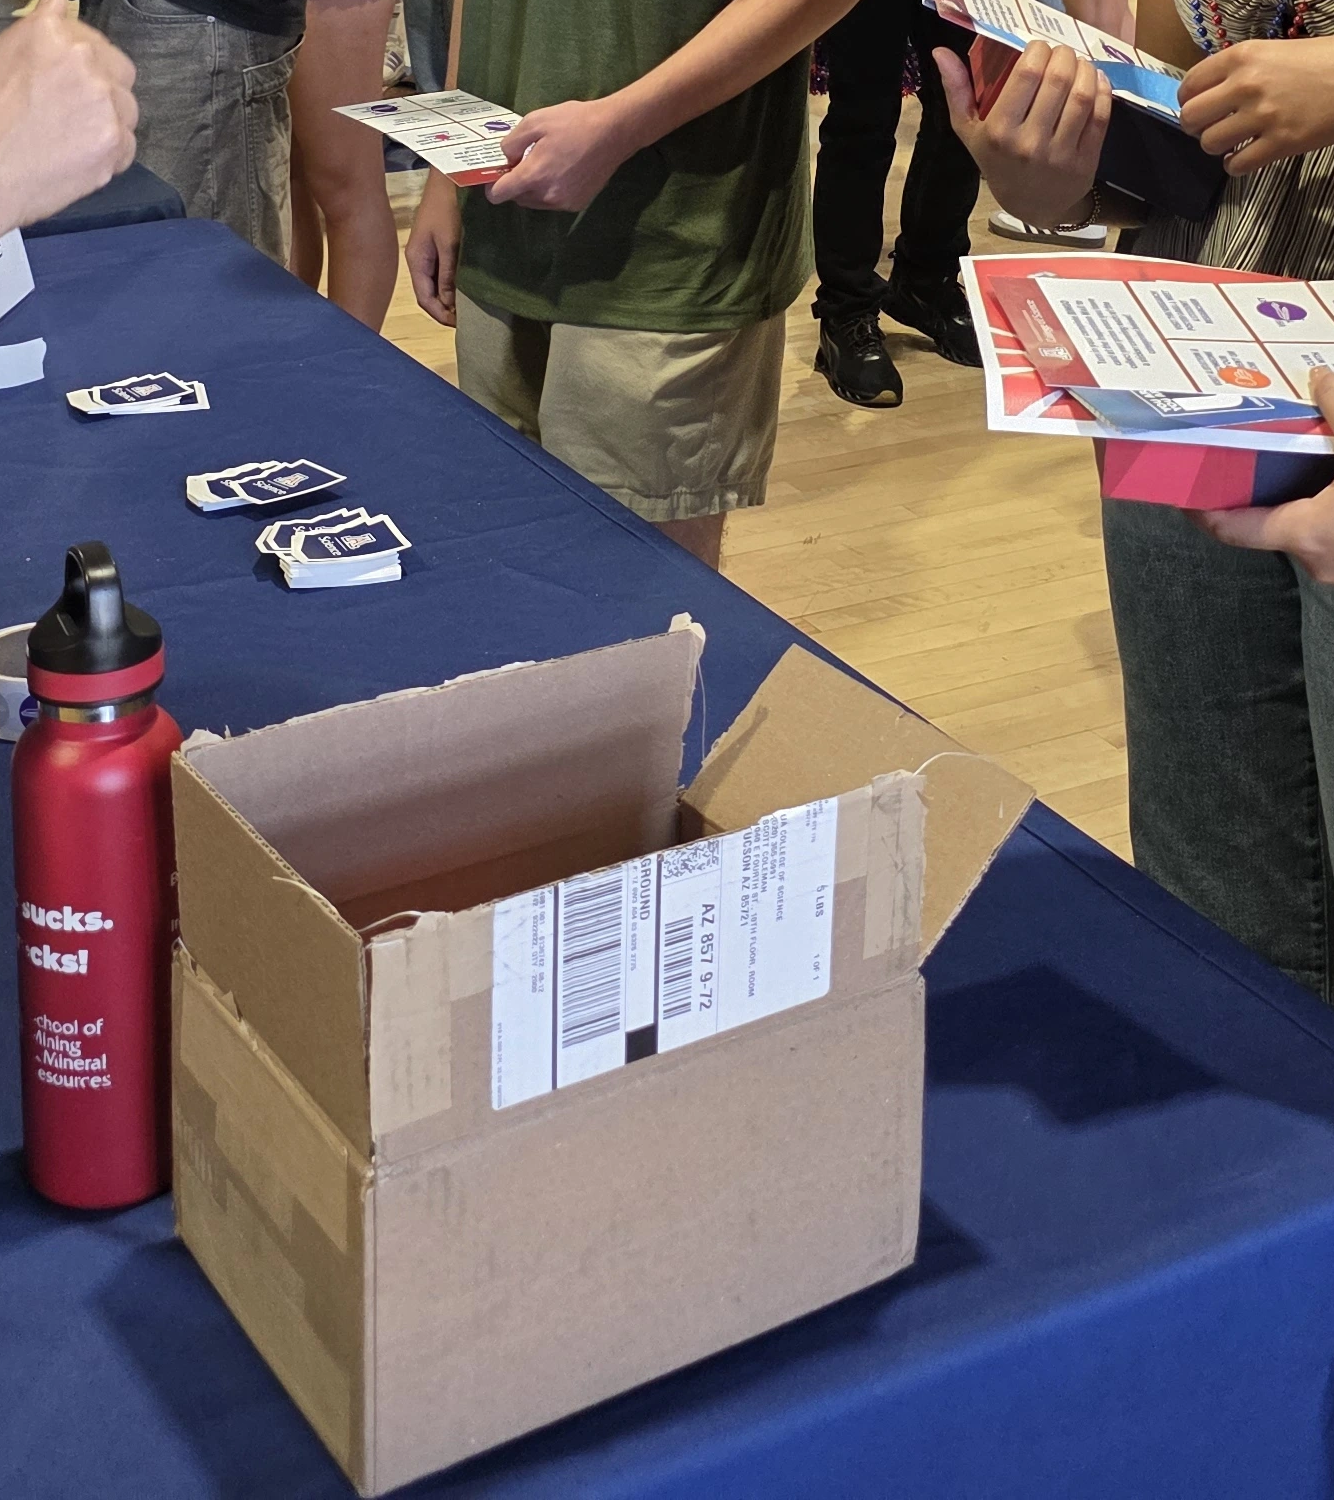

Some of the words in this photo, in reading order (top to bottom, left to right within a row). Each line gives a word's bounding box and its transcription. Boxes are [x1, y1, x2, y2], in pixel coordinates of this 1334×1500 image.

[252, 480, 286, 495] Science
[318, 535, 341, 556] Science
[762, 819, 770, 848] SCOTT
[778, 829, 787, 868] COLLEGE
[741, 876, 750, 890] AZ
[752, 854, 760, 890] FOURTH
[760, 851, 769, 893] COLEMAN
[777, 871, 785, 882] OF
[640, 858, 652, 921] GROUND
[701, 904, 715, 927] AZ
[740, 894, 750, 927] 85721
[775, 885, 784, 921] SCIENCE
[814, 896, 825, 918] LBS
[750, 912, 758, 934] 10TH
[26, 944, 89, 974] cks!
[700, 933, 714, 964] 857
[813, 961, 820, 972] OF
[699, 972, 713, 1012] 9-72
[34, 1014, 78, 1035] chool
[83, 1018, 104, 1036] of
[38, 1068, 112, 1088] esources
